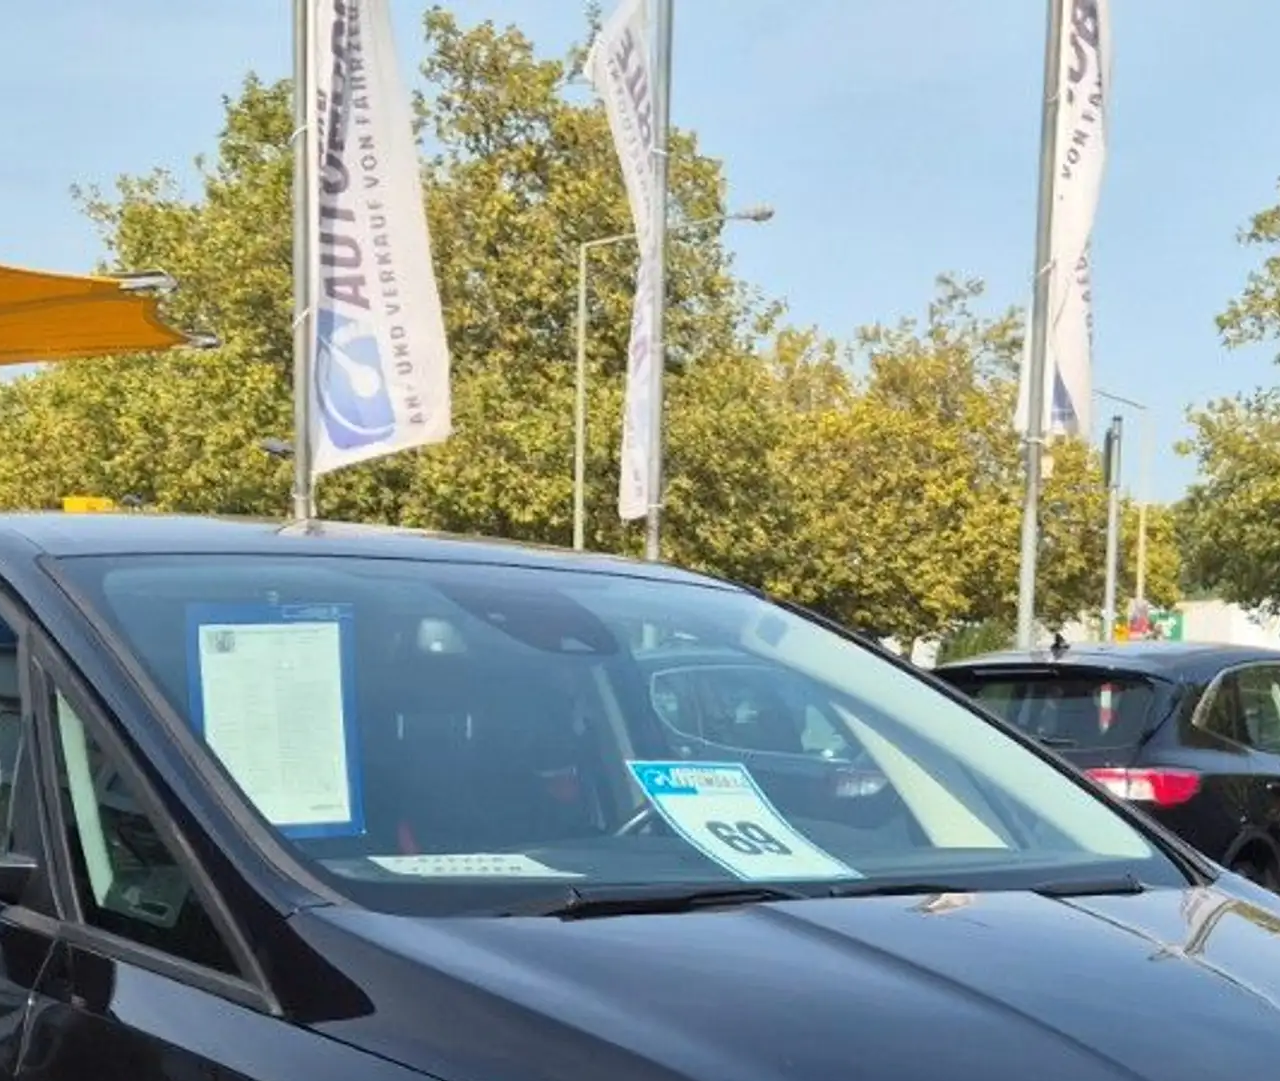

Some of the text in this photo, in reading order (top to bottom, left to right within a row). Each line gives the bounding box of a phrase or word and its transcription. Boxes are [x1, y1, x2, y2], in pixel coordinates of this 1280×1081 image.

[358, 134, 380, 189] VON
[367, 198, 402, 316] VERKAUF
[390, 325, 413, 376] UND
[704, 821, 793, 855] 69
